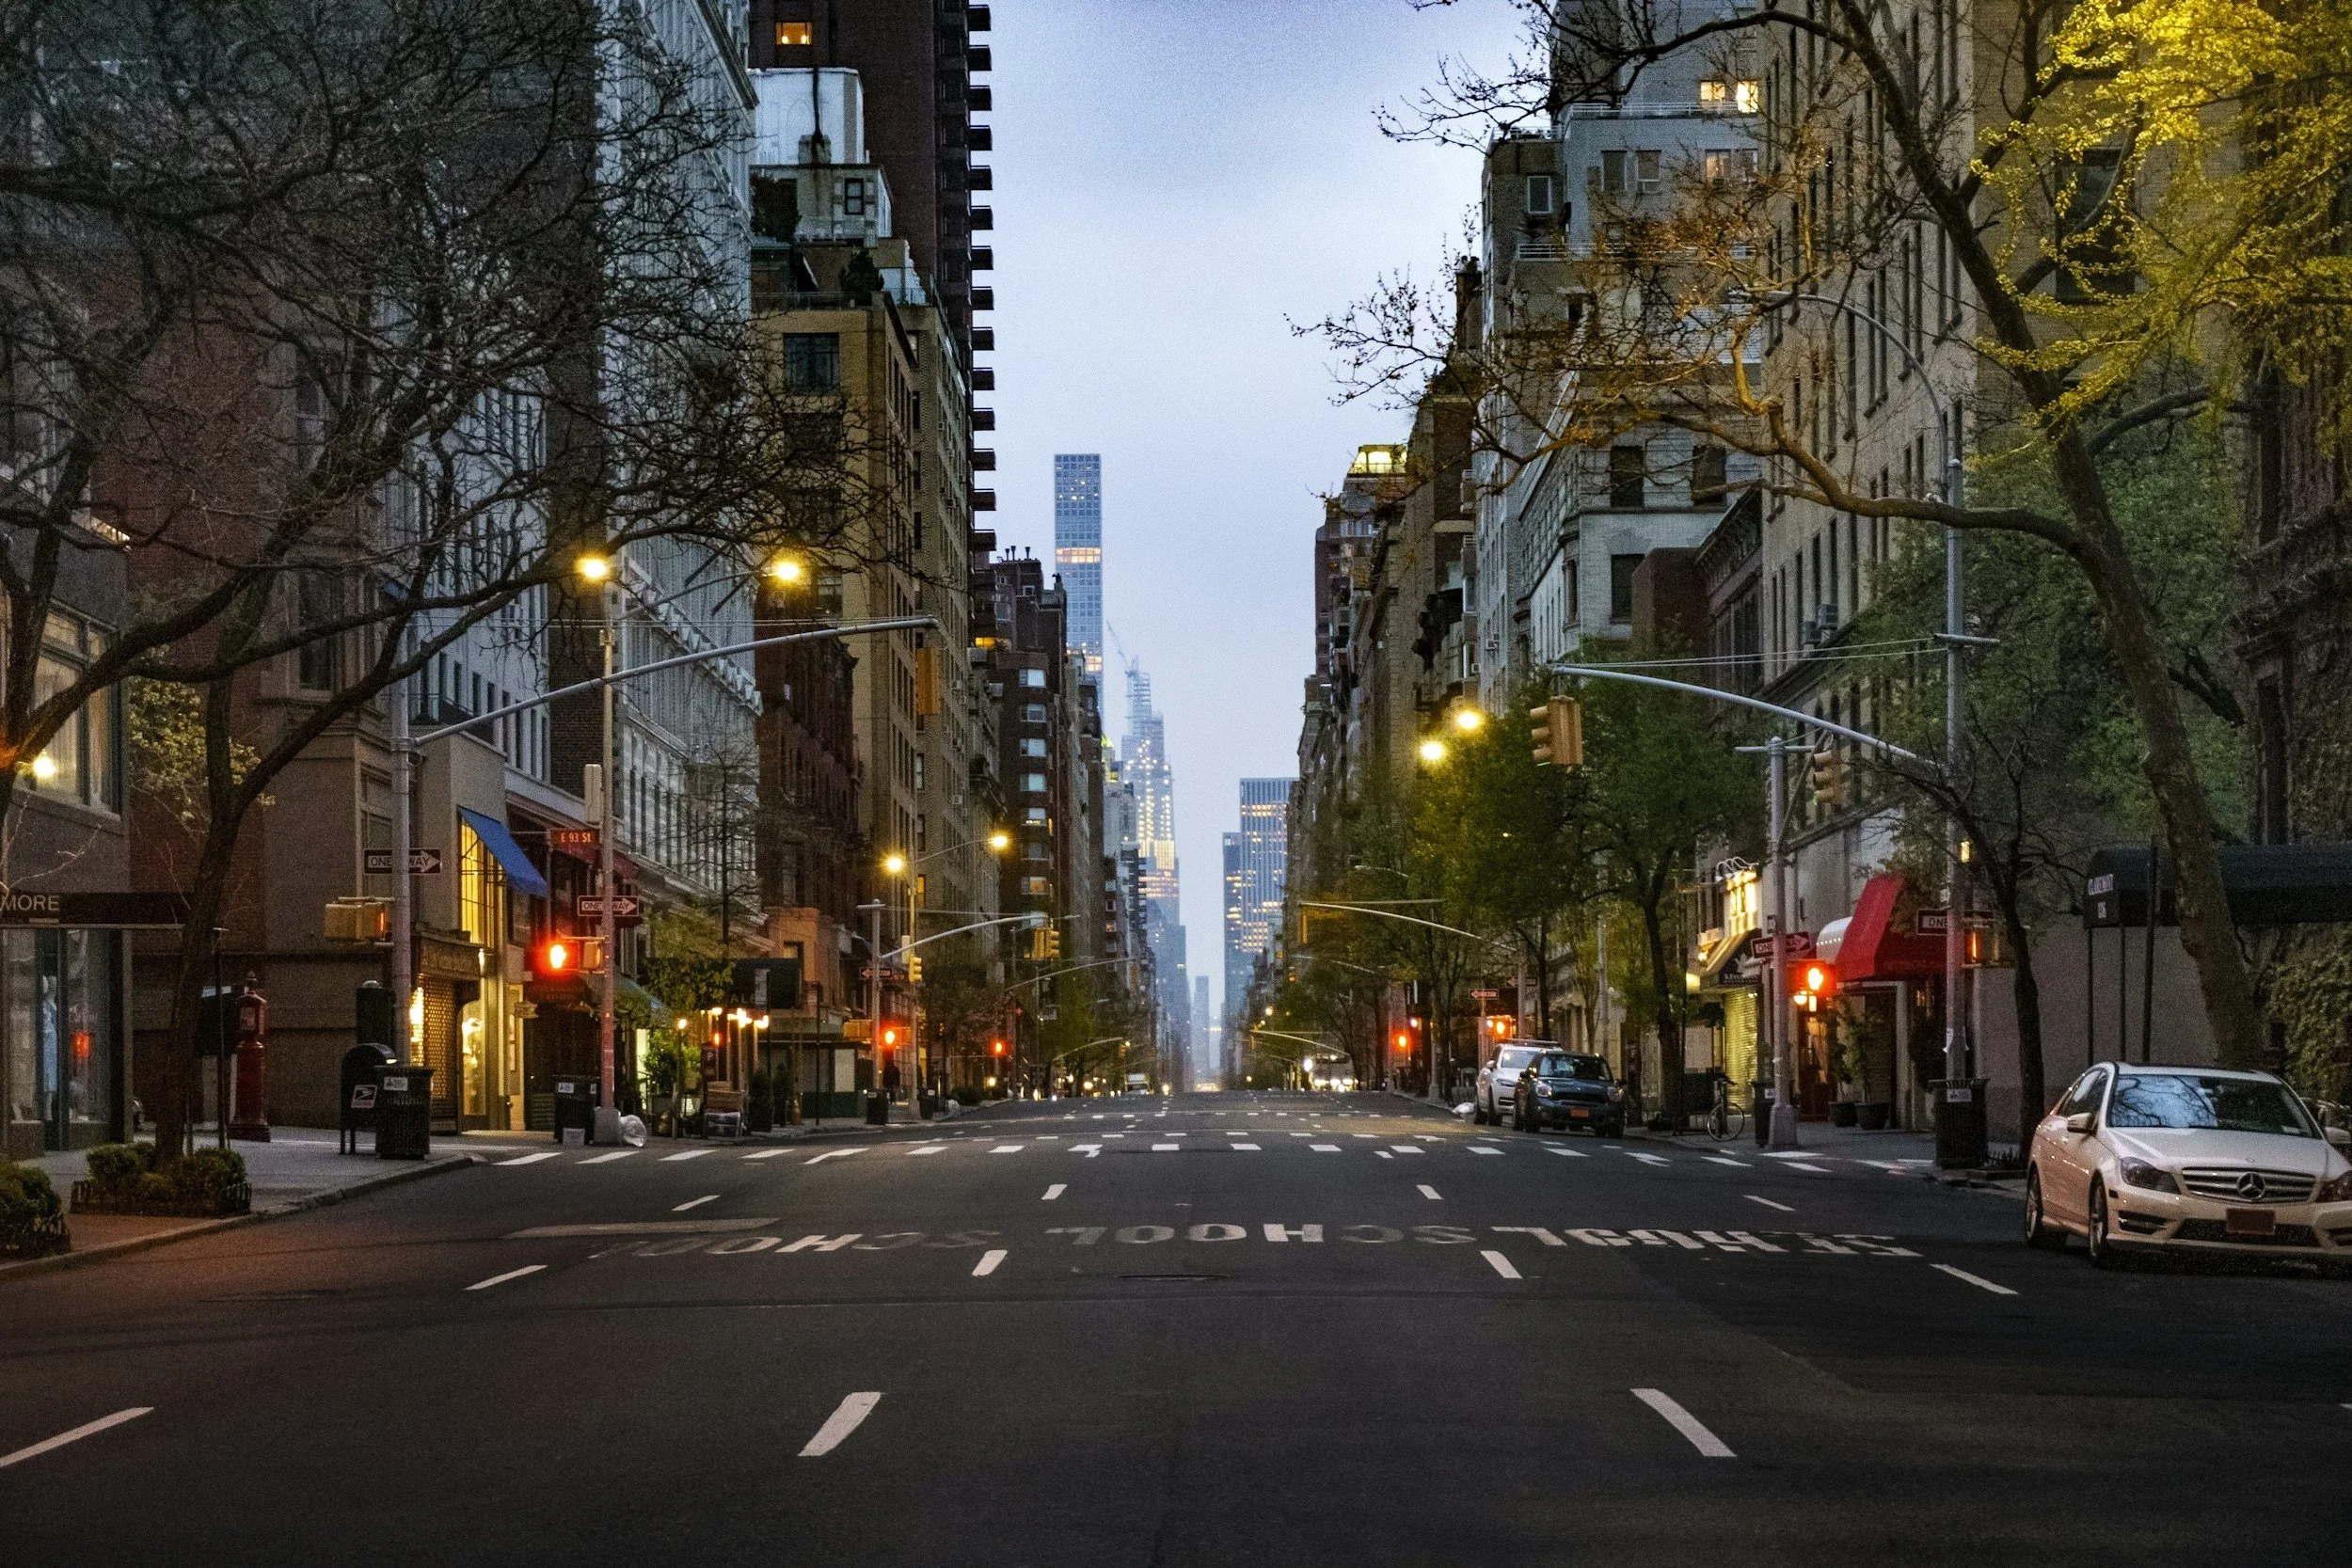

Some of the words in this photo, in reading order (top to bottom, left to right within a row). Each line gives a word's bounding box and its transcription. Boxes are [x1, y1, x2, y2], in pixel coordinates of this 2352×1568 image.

[561, 833, 565, 842] E
[569, 833, 579, 842] 93
[371, 857, 392, 865] ONE
[584, 901, 601, 911] ONE
[1044, 1224, 1476, 1244] SCHOOL
